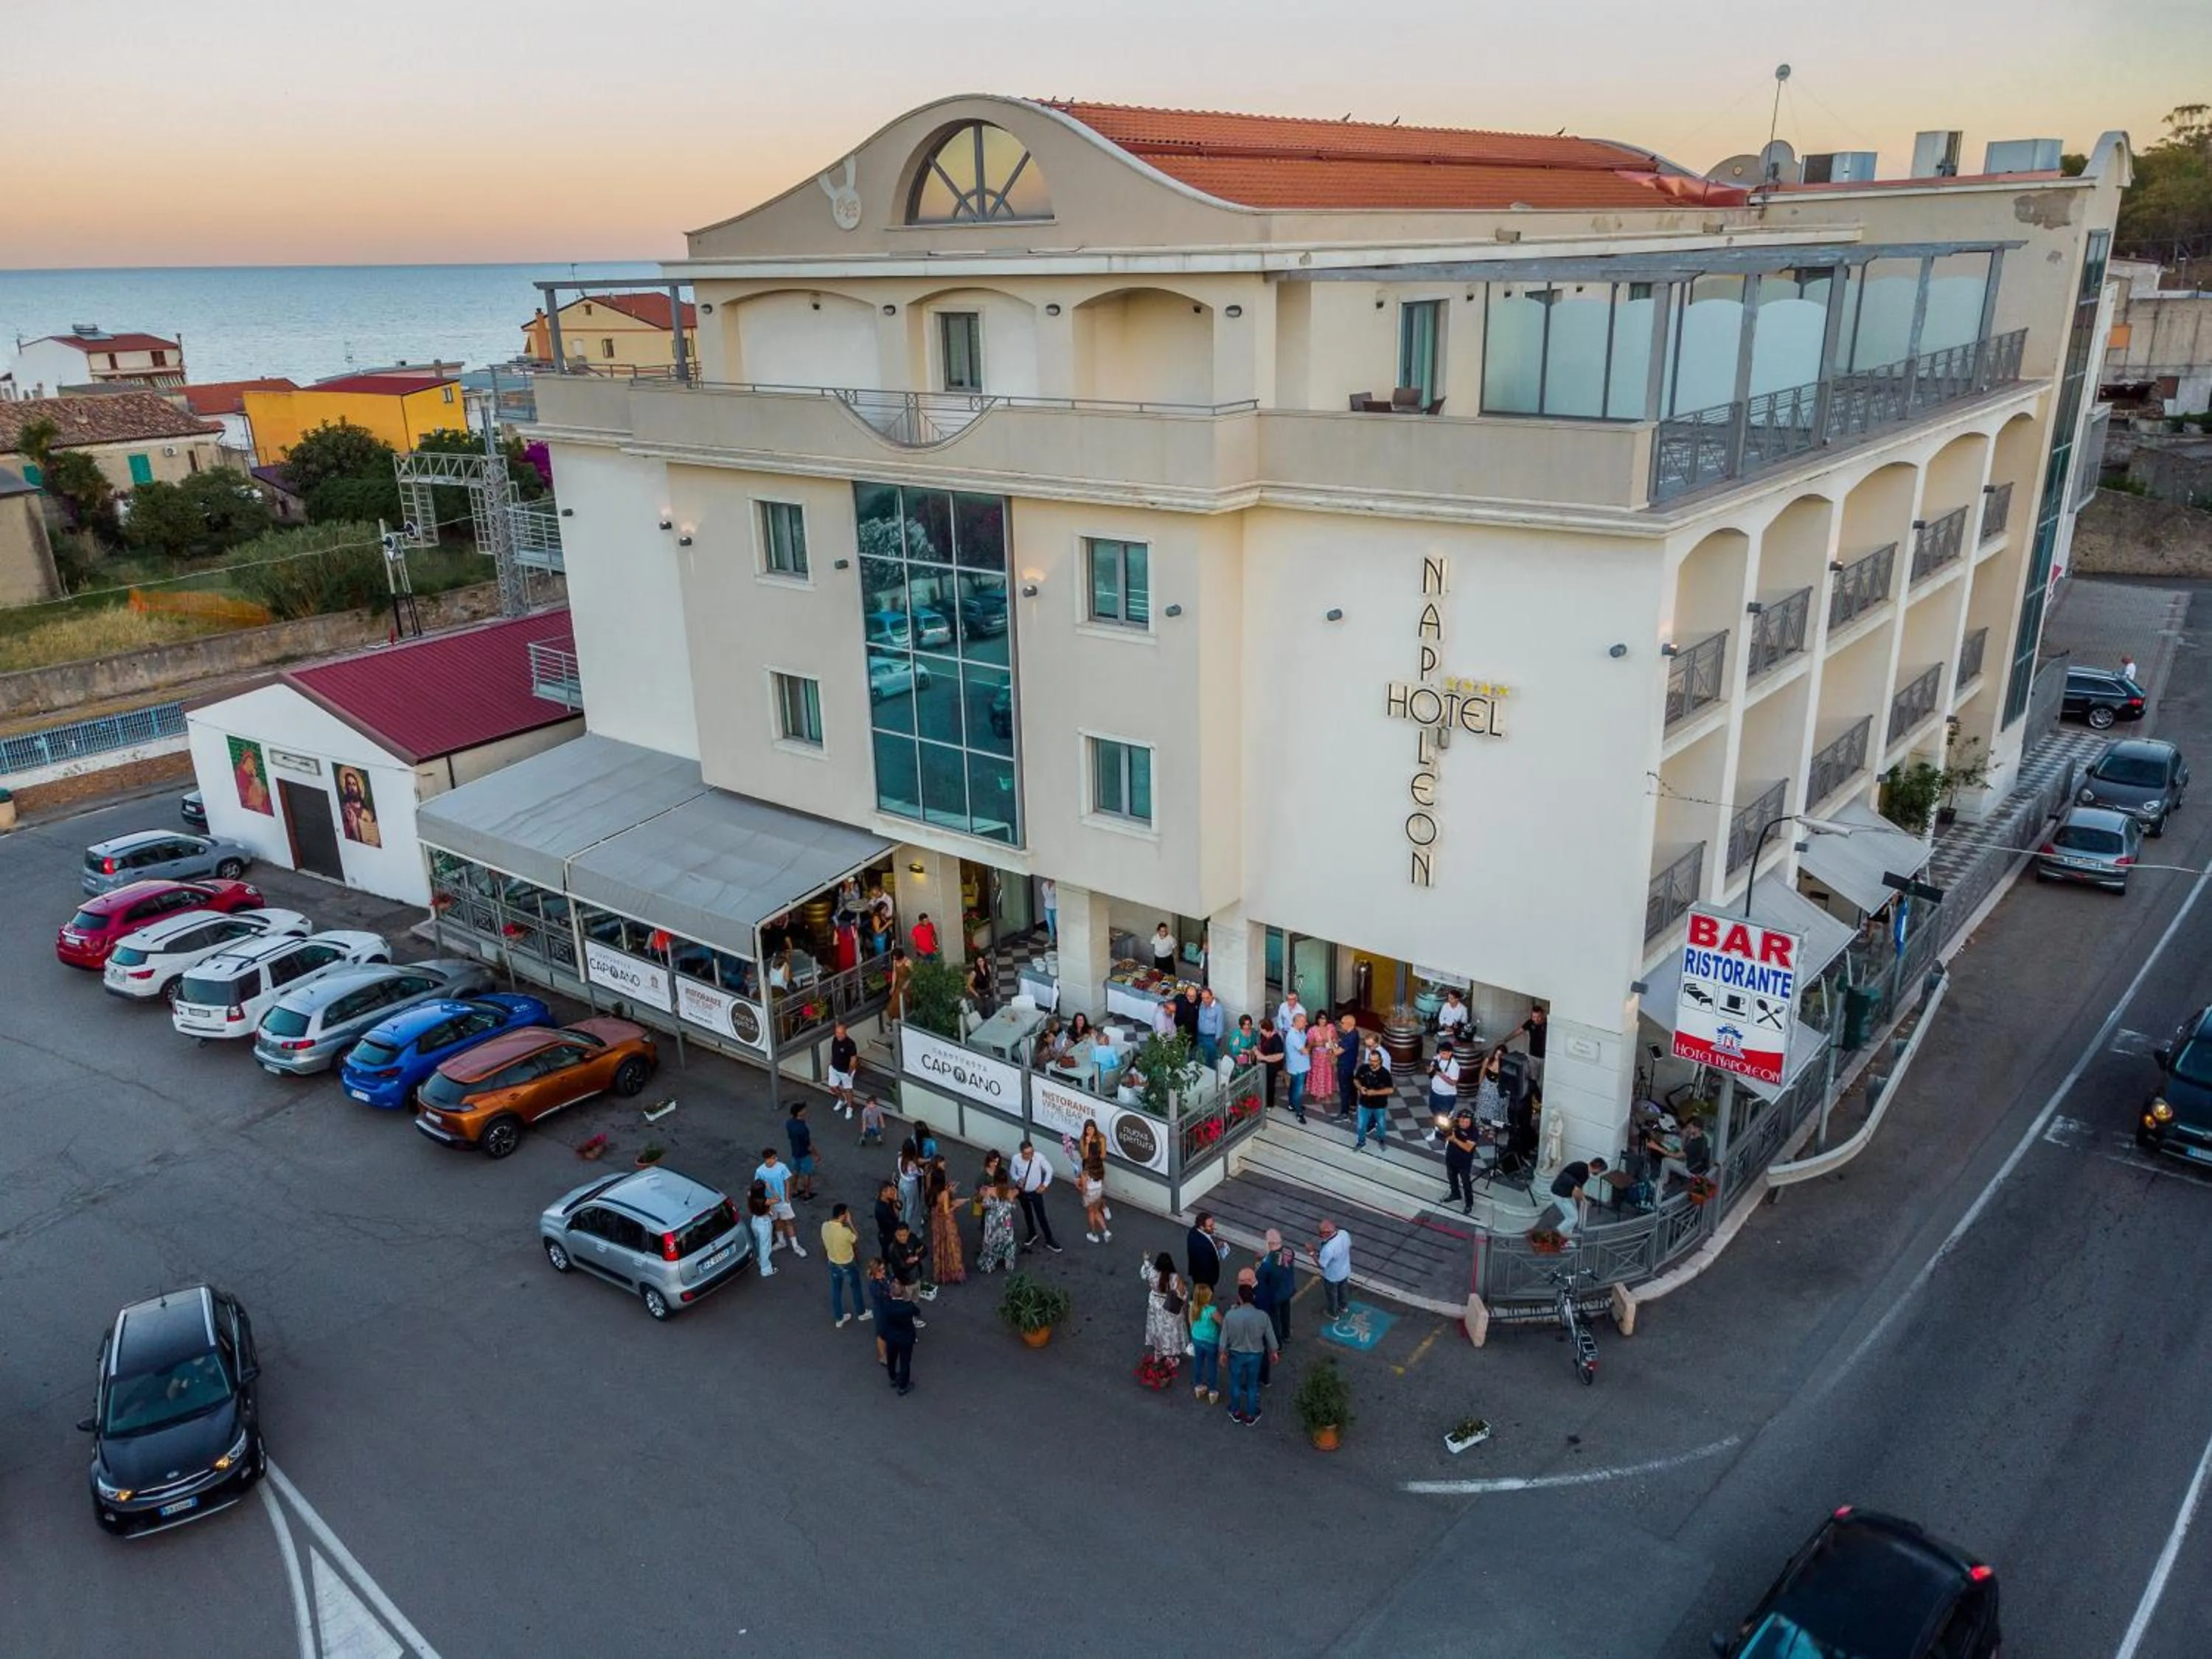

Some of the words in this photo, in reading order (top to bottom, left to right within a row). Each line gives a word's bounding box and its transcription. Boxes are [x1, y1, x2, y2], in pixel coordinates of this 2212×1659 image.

[1387, 683, 1503, 738] HOTEL
[1405, 557, 1444, 887] NAPOLEON
[1688, 914, 1795, 970] BAR
[1684, 947, 1793, 999] RISTORANTE
[1042, 1089, 1096, 1119] RISTORANTE
